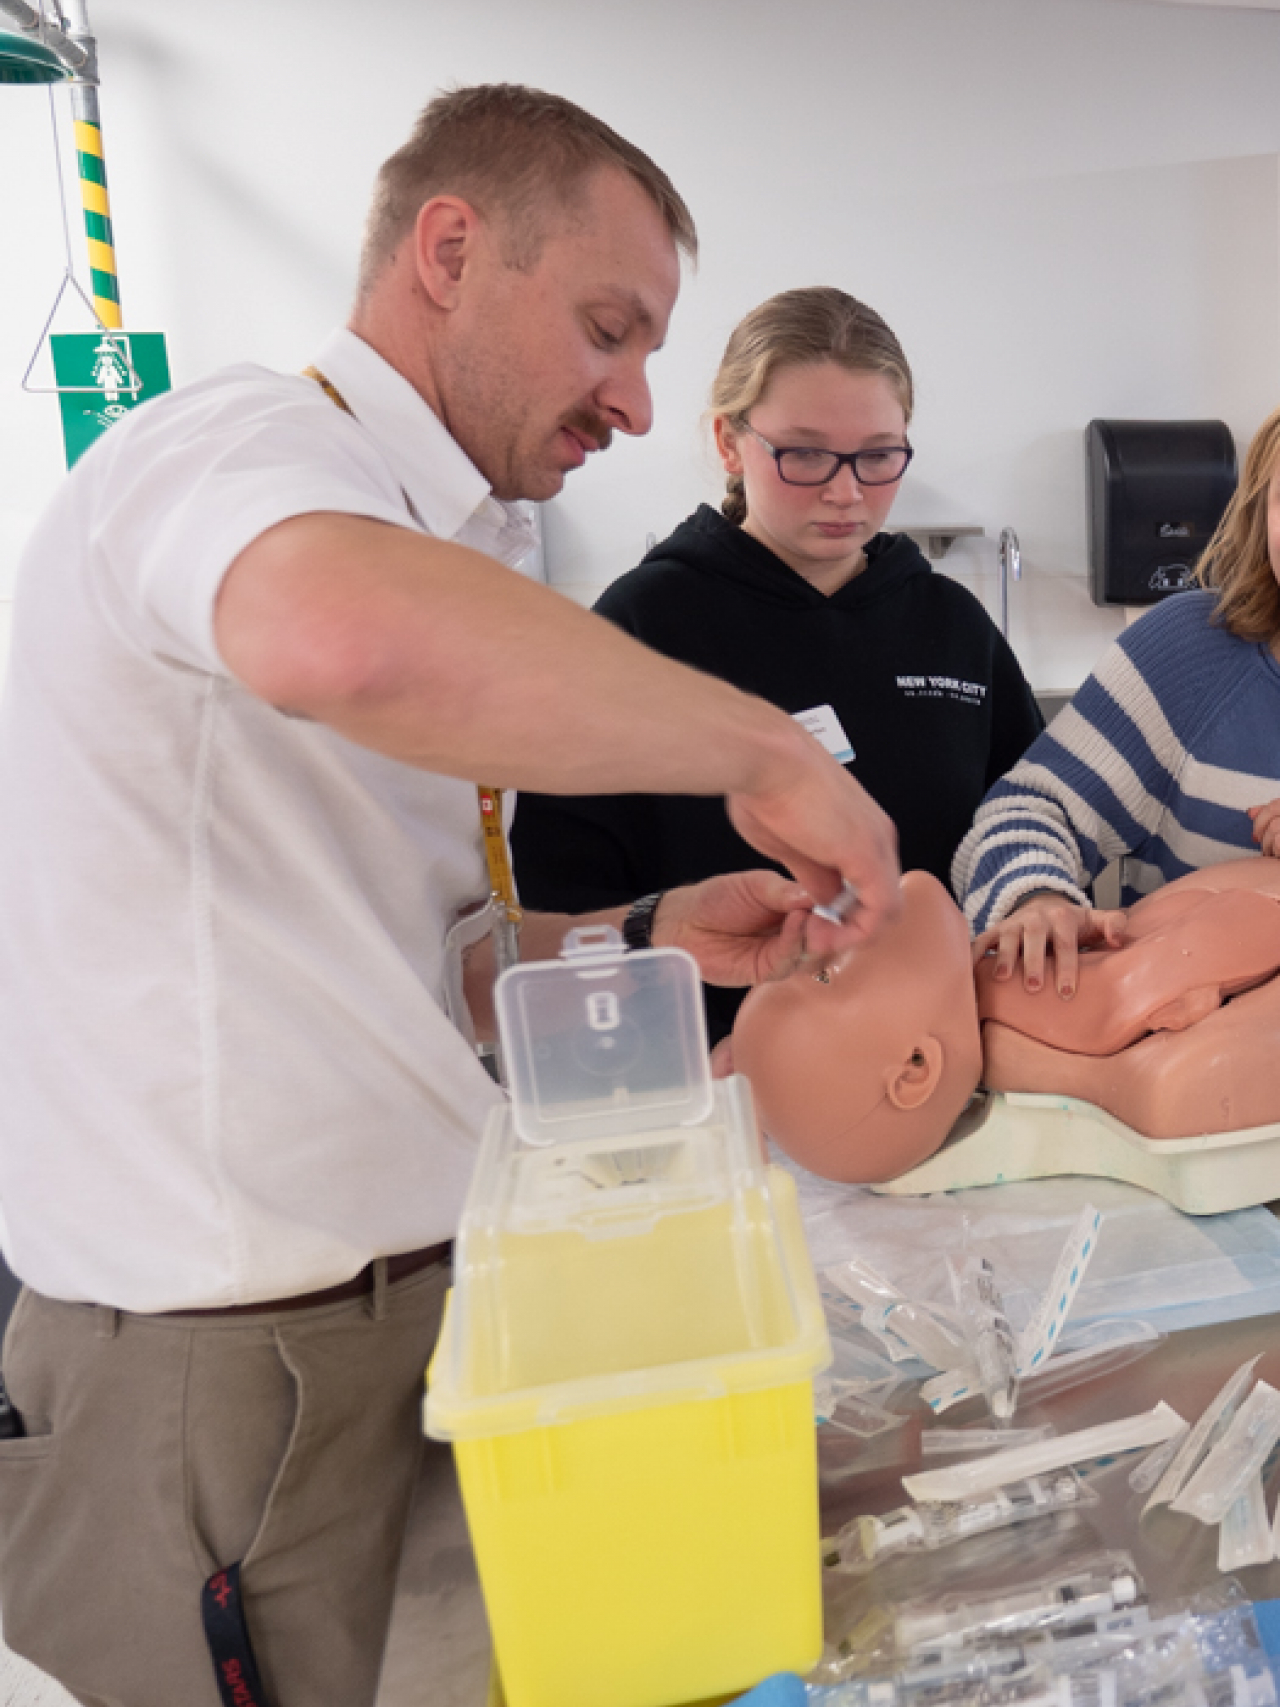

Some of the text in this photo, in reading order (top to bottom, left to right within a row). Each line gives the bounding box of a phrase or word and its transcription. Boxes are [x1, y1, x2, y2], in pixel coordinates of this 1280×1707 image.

[896, 676, 926, 688] NEW
[928, 676, 960, 691] YORK
[962, 681, 987, 698] CITY
